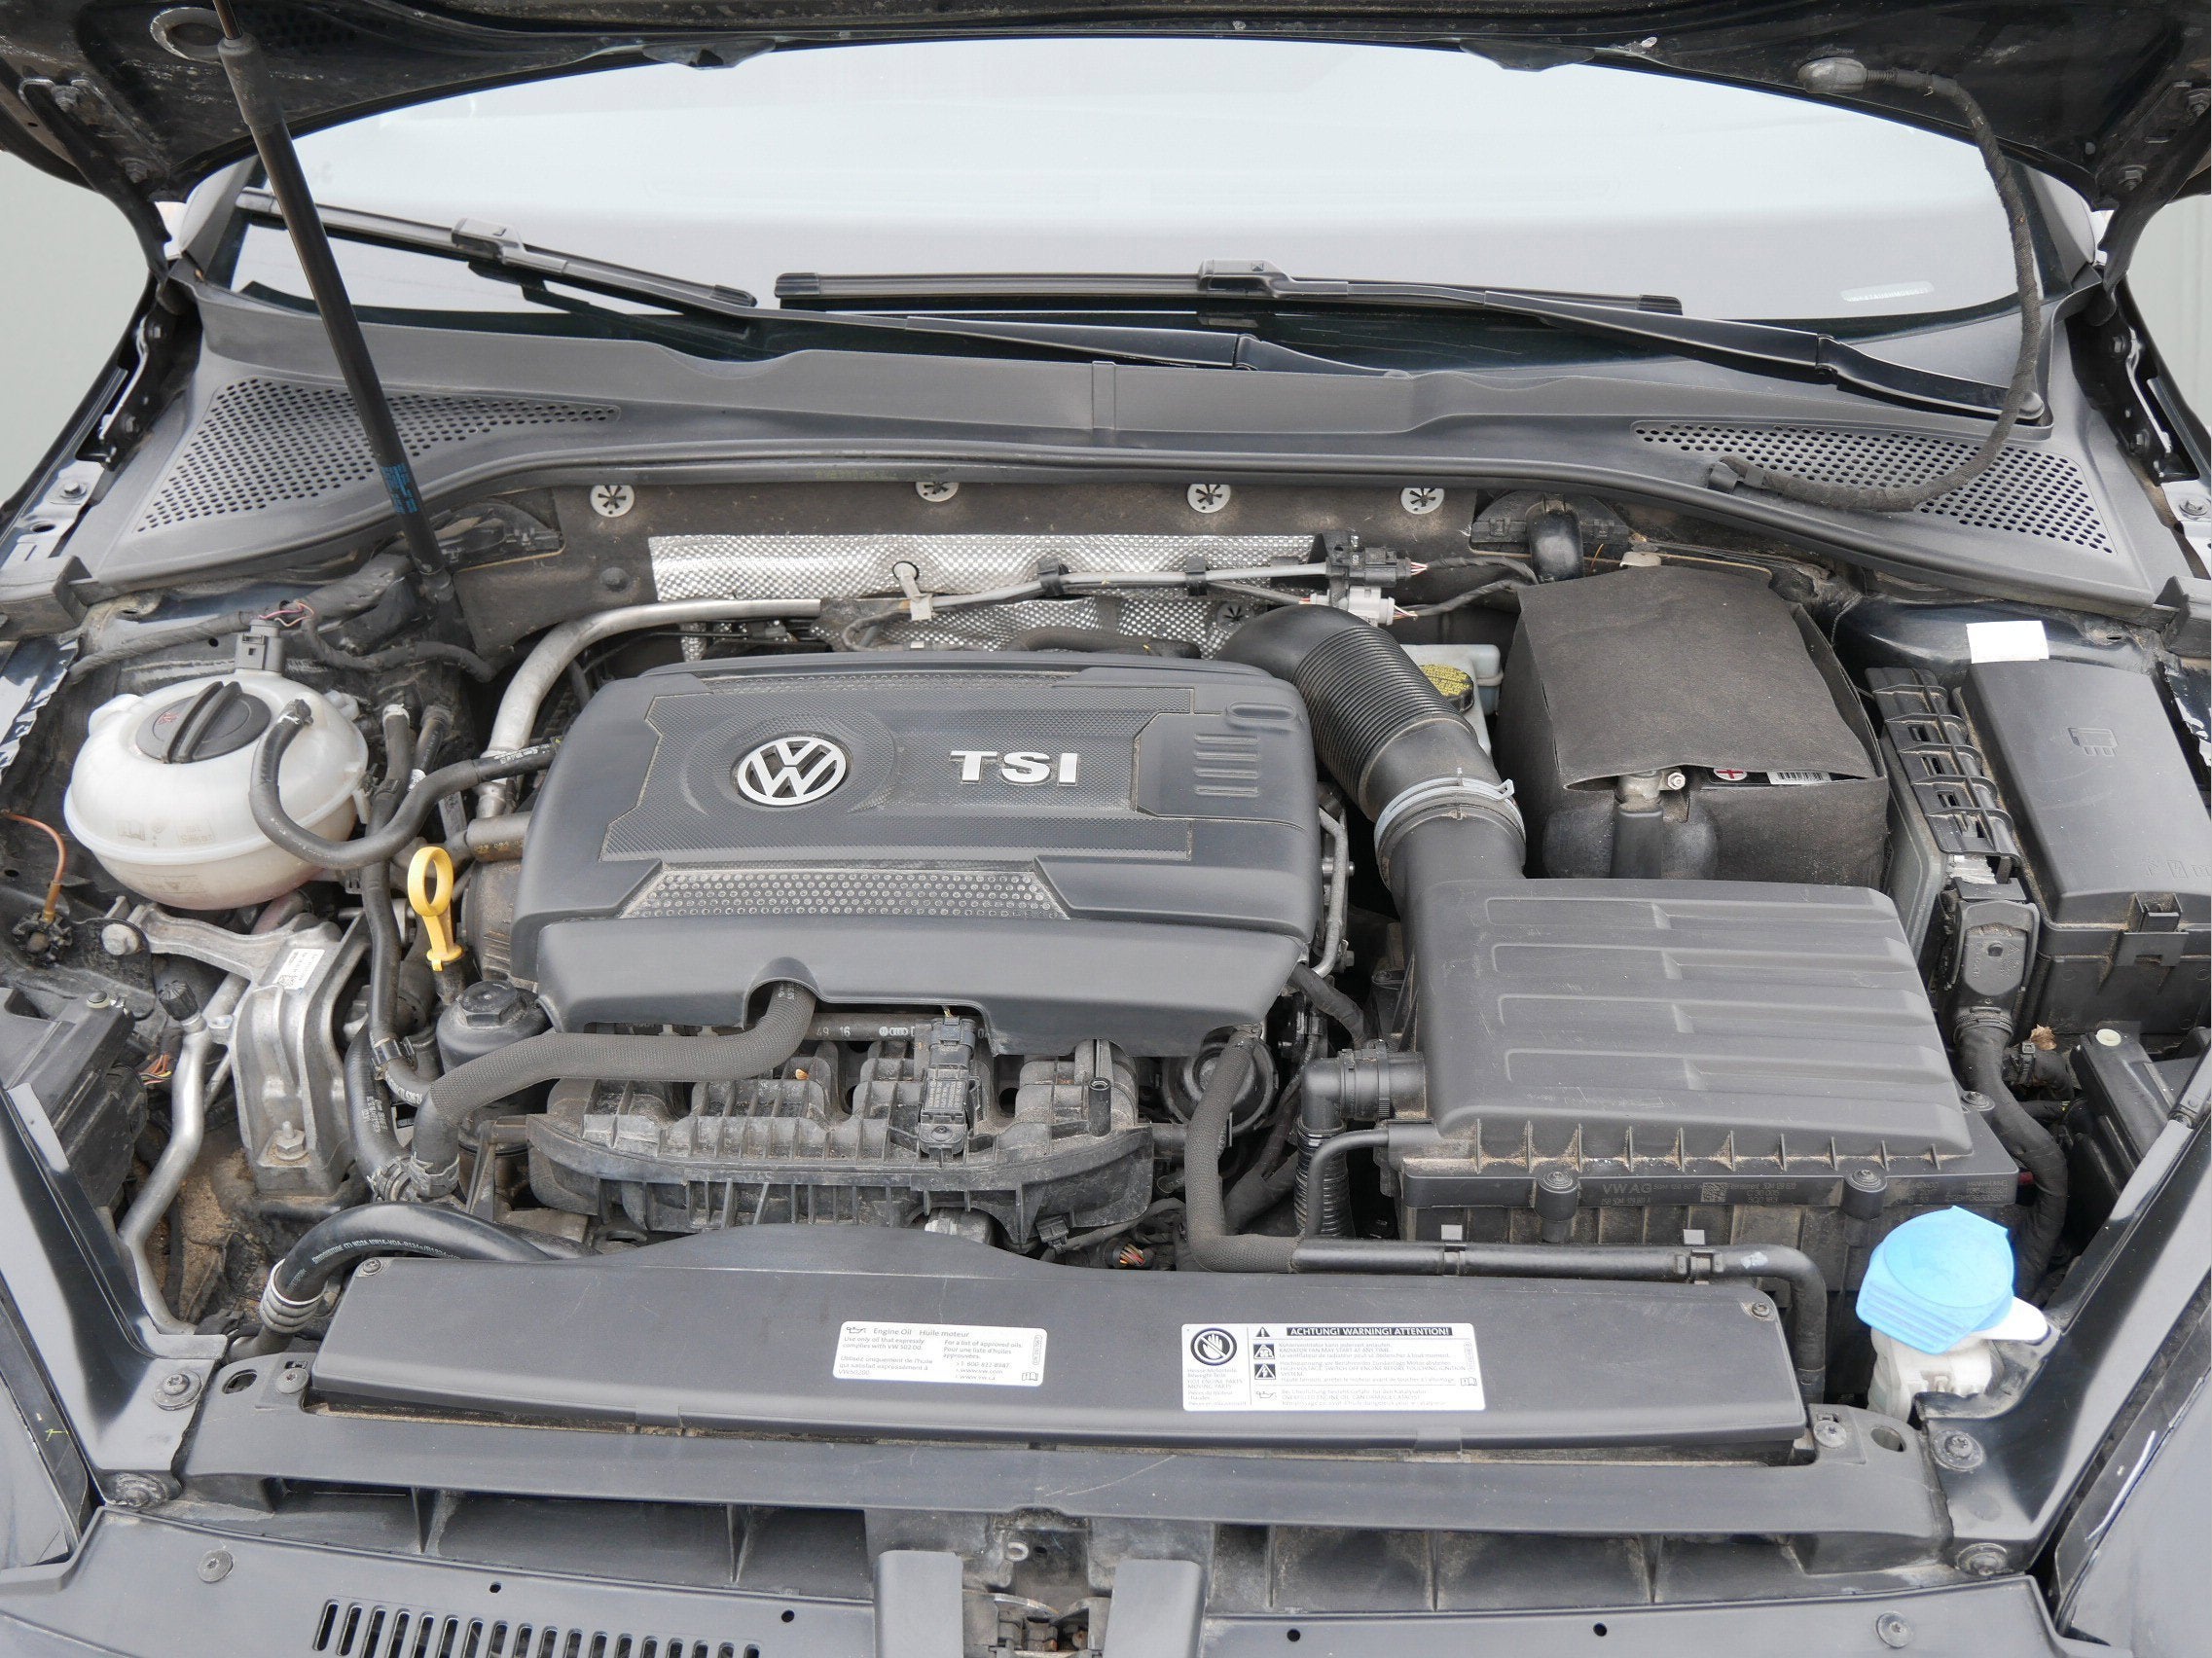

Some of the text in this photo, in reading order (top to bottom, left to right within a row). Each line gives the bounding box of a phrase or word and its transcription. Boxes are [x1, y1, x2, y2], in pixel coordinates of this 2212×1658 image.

[737, 736, 847, 806] VW
[950, 749, 1079, 784] TSI
[840, 1027, 851, 1037] 16
[873, 1328, 899, 1337] Engine
[1290, 1327, 1449, 1336] ACHTUNG! WARNING! ATTENTION!
